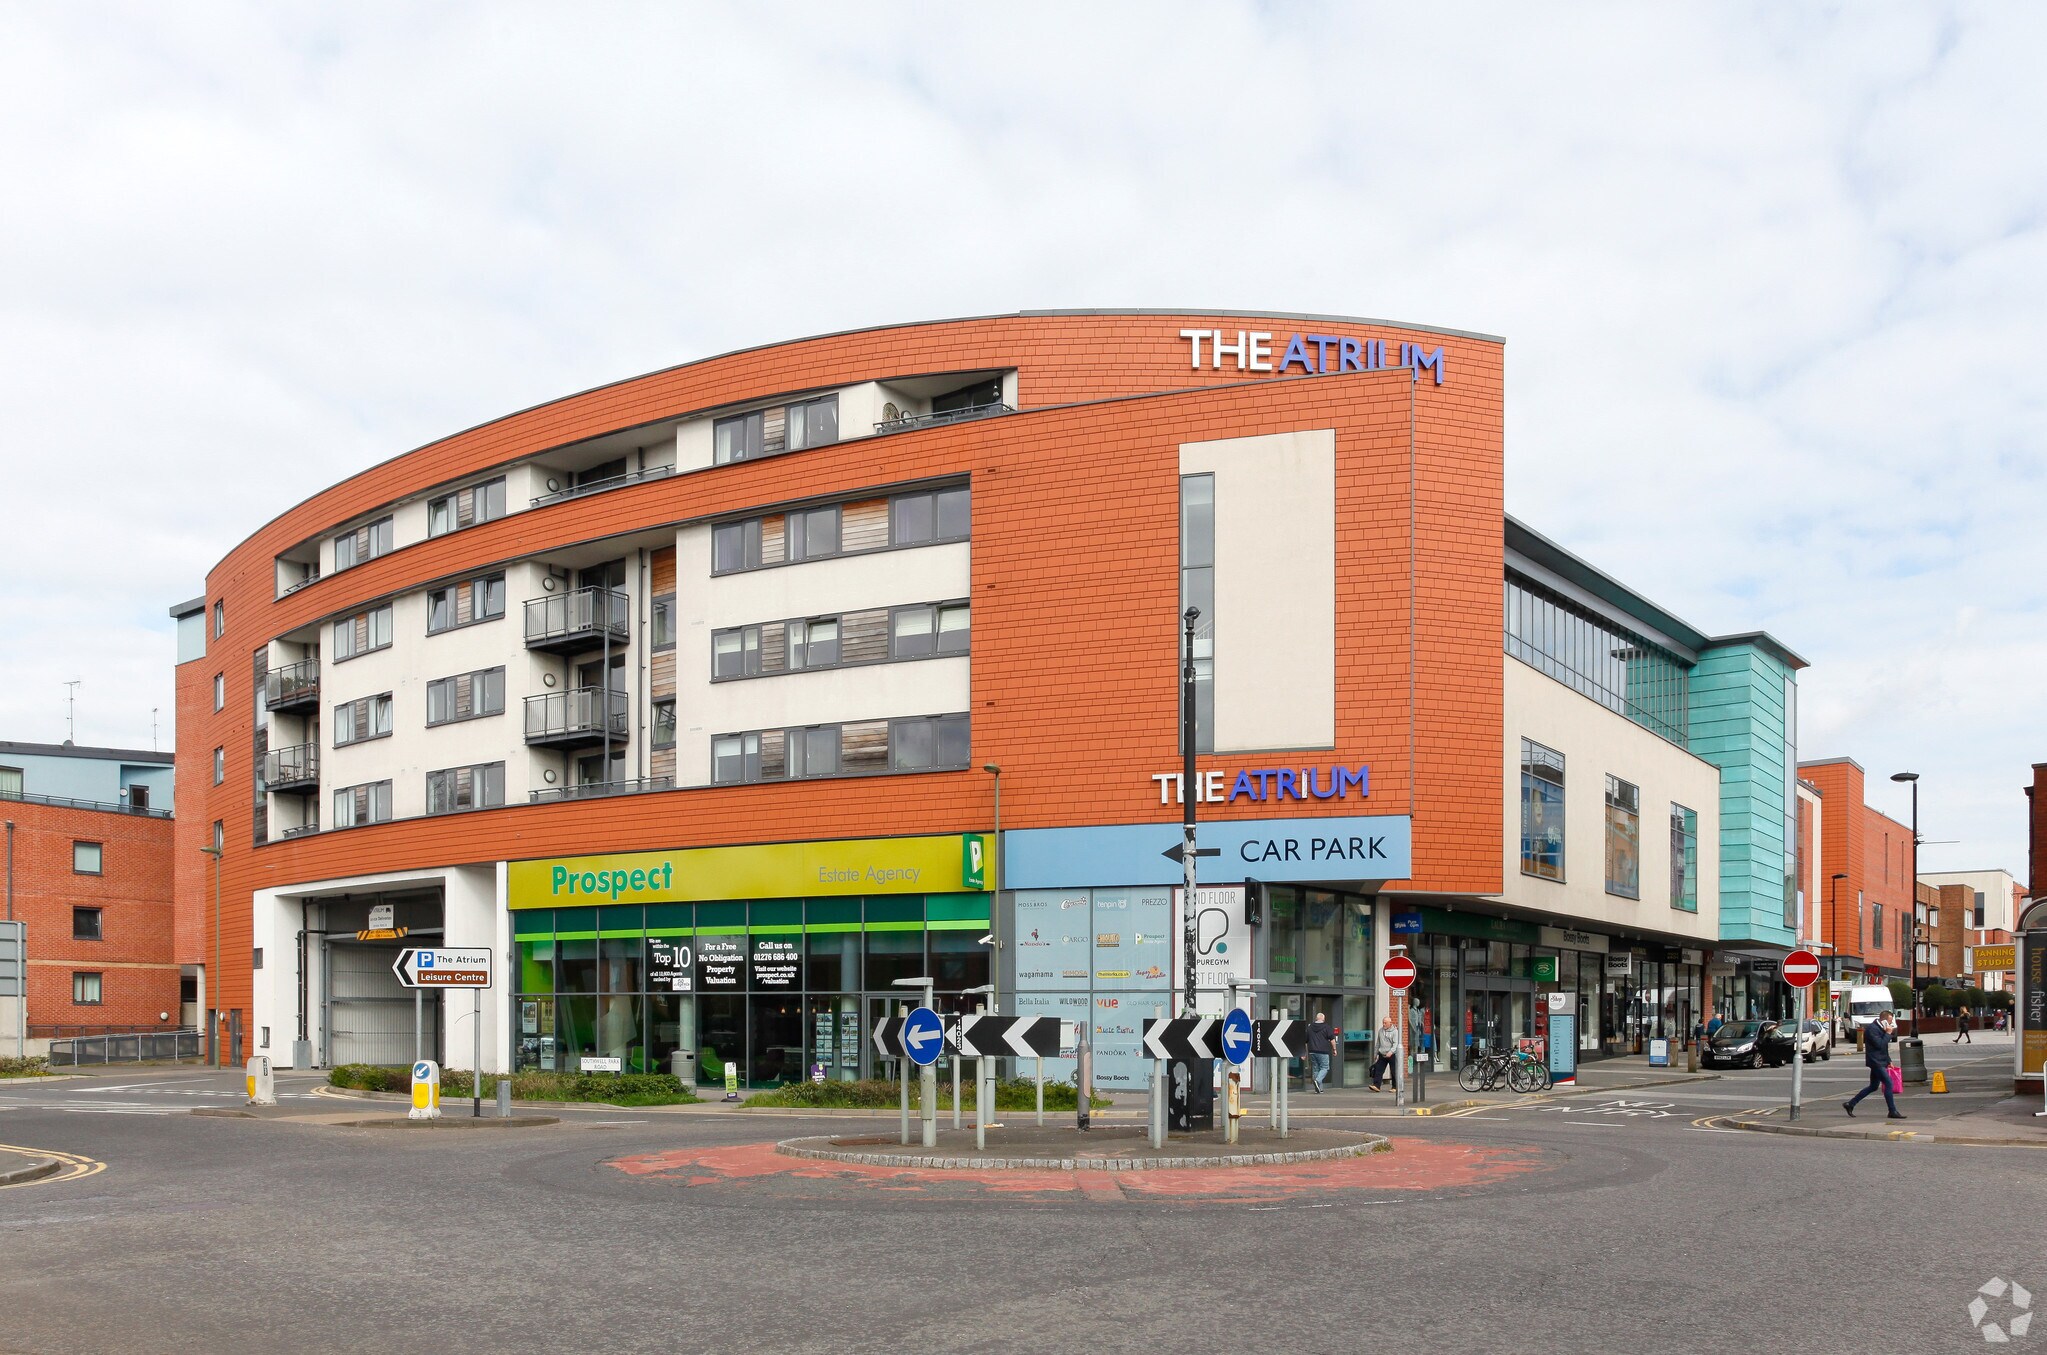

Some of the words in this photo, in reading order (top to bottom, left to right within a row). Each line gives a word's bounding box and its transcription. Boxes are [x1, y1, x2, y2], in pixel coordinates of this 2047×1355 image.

[1179, 329, 1273, 371] THE
[1278, 333, 1446, 385] ATRIUM
[1152, 770, 1225, 804] THE
[1228, 765, 1369, 802] ATRIUM
[1240, 839, 1300, 863] CAR
[1311, 836, 1387, 861] PARK
[819, 867, 859, 883] Estate
[864, 865, 921, 884] Agency
[552, 861, 673, 901] Prospect
[1141, 898, 1168, 906] PREZZO
[1208, 891, 1236, 905] FLOOR
[1097, 901, 1118, 909] tenpin
[1062, 935, 1088, 943] CARGO
[1563, 930, 1577, 945] Bossy
[1576, 932, 1590, 945] Boots
[653, 953, 671, 965] Top
[673, 946, 691, 968] 10
[698, 954, 708, 962] No
[709, 954, 744, 963] Obligation
[753, 953, 772, 961] 01276
[772, 953, 785, 961] 686
[1975, 948, 2015, 957] TANNING
[421, 953, 432, 966] P
[1977, 959, 2014, 967] STUDIO
[2031, 947, 2046, 983] house
[706, 965, 735, 974] Property
[1019, 971, 1054, 979] wagamama
[421, 973, 452, 981] Leisure
[454, 973, 485, 981] Centre
[705, 976, 736, 984] Valuation
[1195, 972, 1205, 985] ST
[1096, 998, 1119, 1009] vue
[2030, 990, 2046, 1023] fisher
